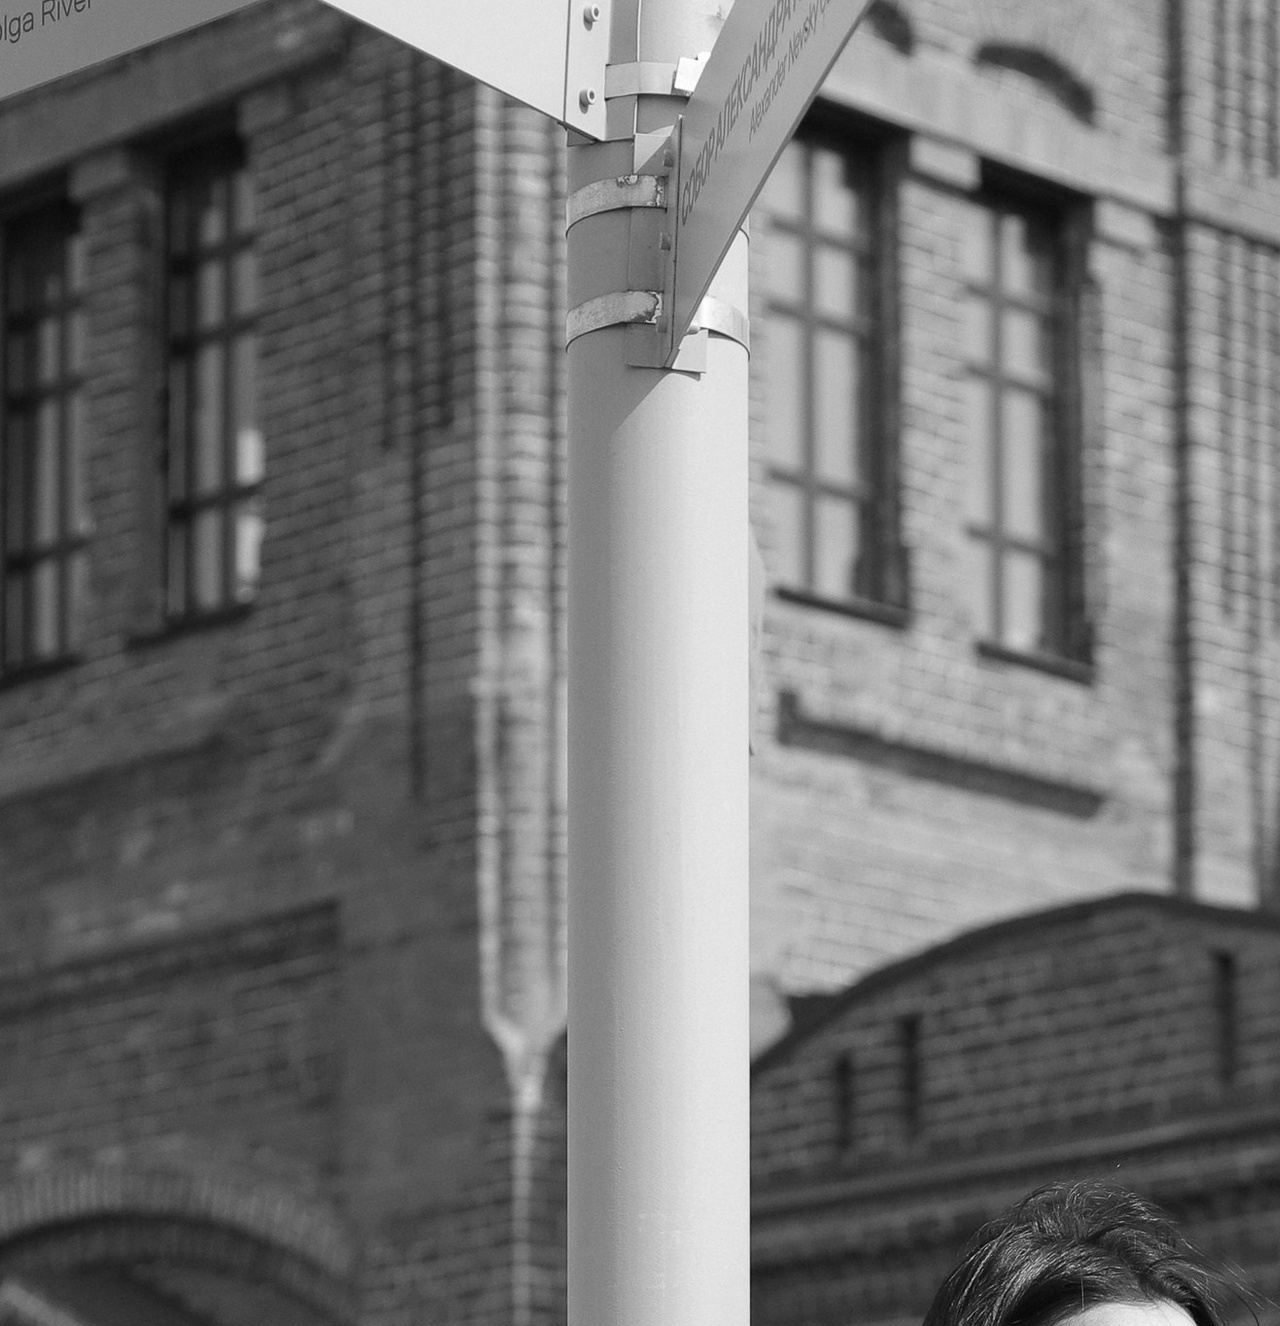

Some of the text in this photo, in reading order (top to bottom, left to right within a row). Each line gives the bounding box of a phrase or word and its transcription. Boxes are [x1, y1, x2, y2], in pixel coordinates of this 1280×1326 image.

[0, 12, 34, 43] lga
[749, 52, 788, 144] Alexander
[682, 127, 716, 226] СОБОР
